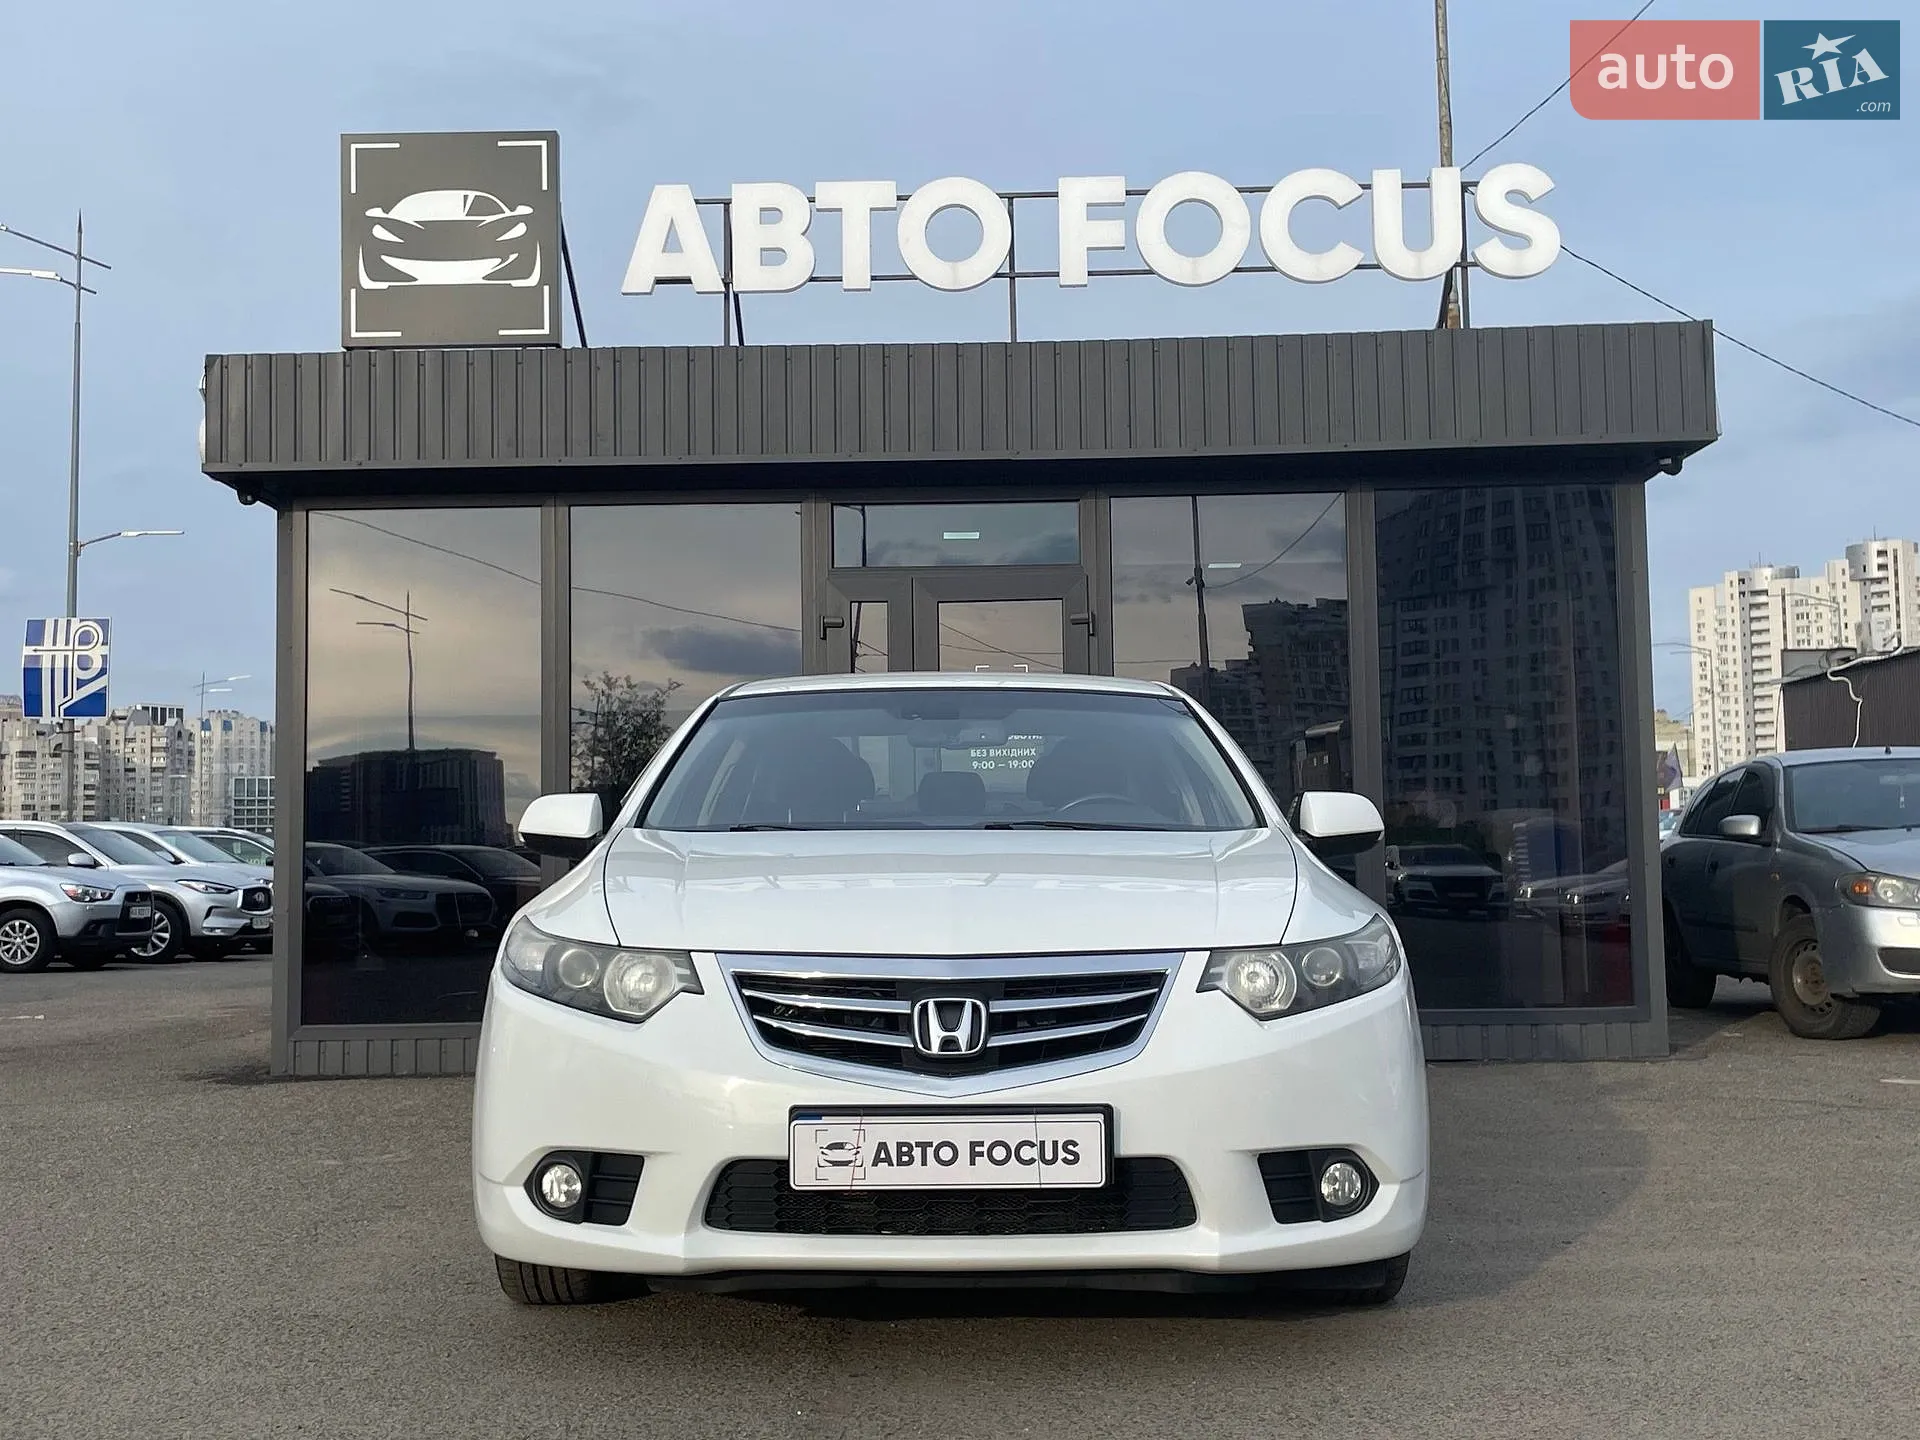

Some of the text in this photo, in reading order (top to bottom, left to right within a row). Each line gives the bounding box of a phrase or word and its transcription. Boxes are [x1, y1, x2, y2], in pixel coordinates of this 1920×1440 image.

[621, 161, 1559, 296] АВТО FOCUS
[989, 748, 1036, 757] ВИХІДНИХ
[972, 761, 995, 769] 9:00
[1008, 760, 1035, 769] 19:00
[871, 1139, 1081, 1167] АВТО FOCUS
